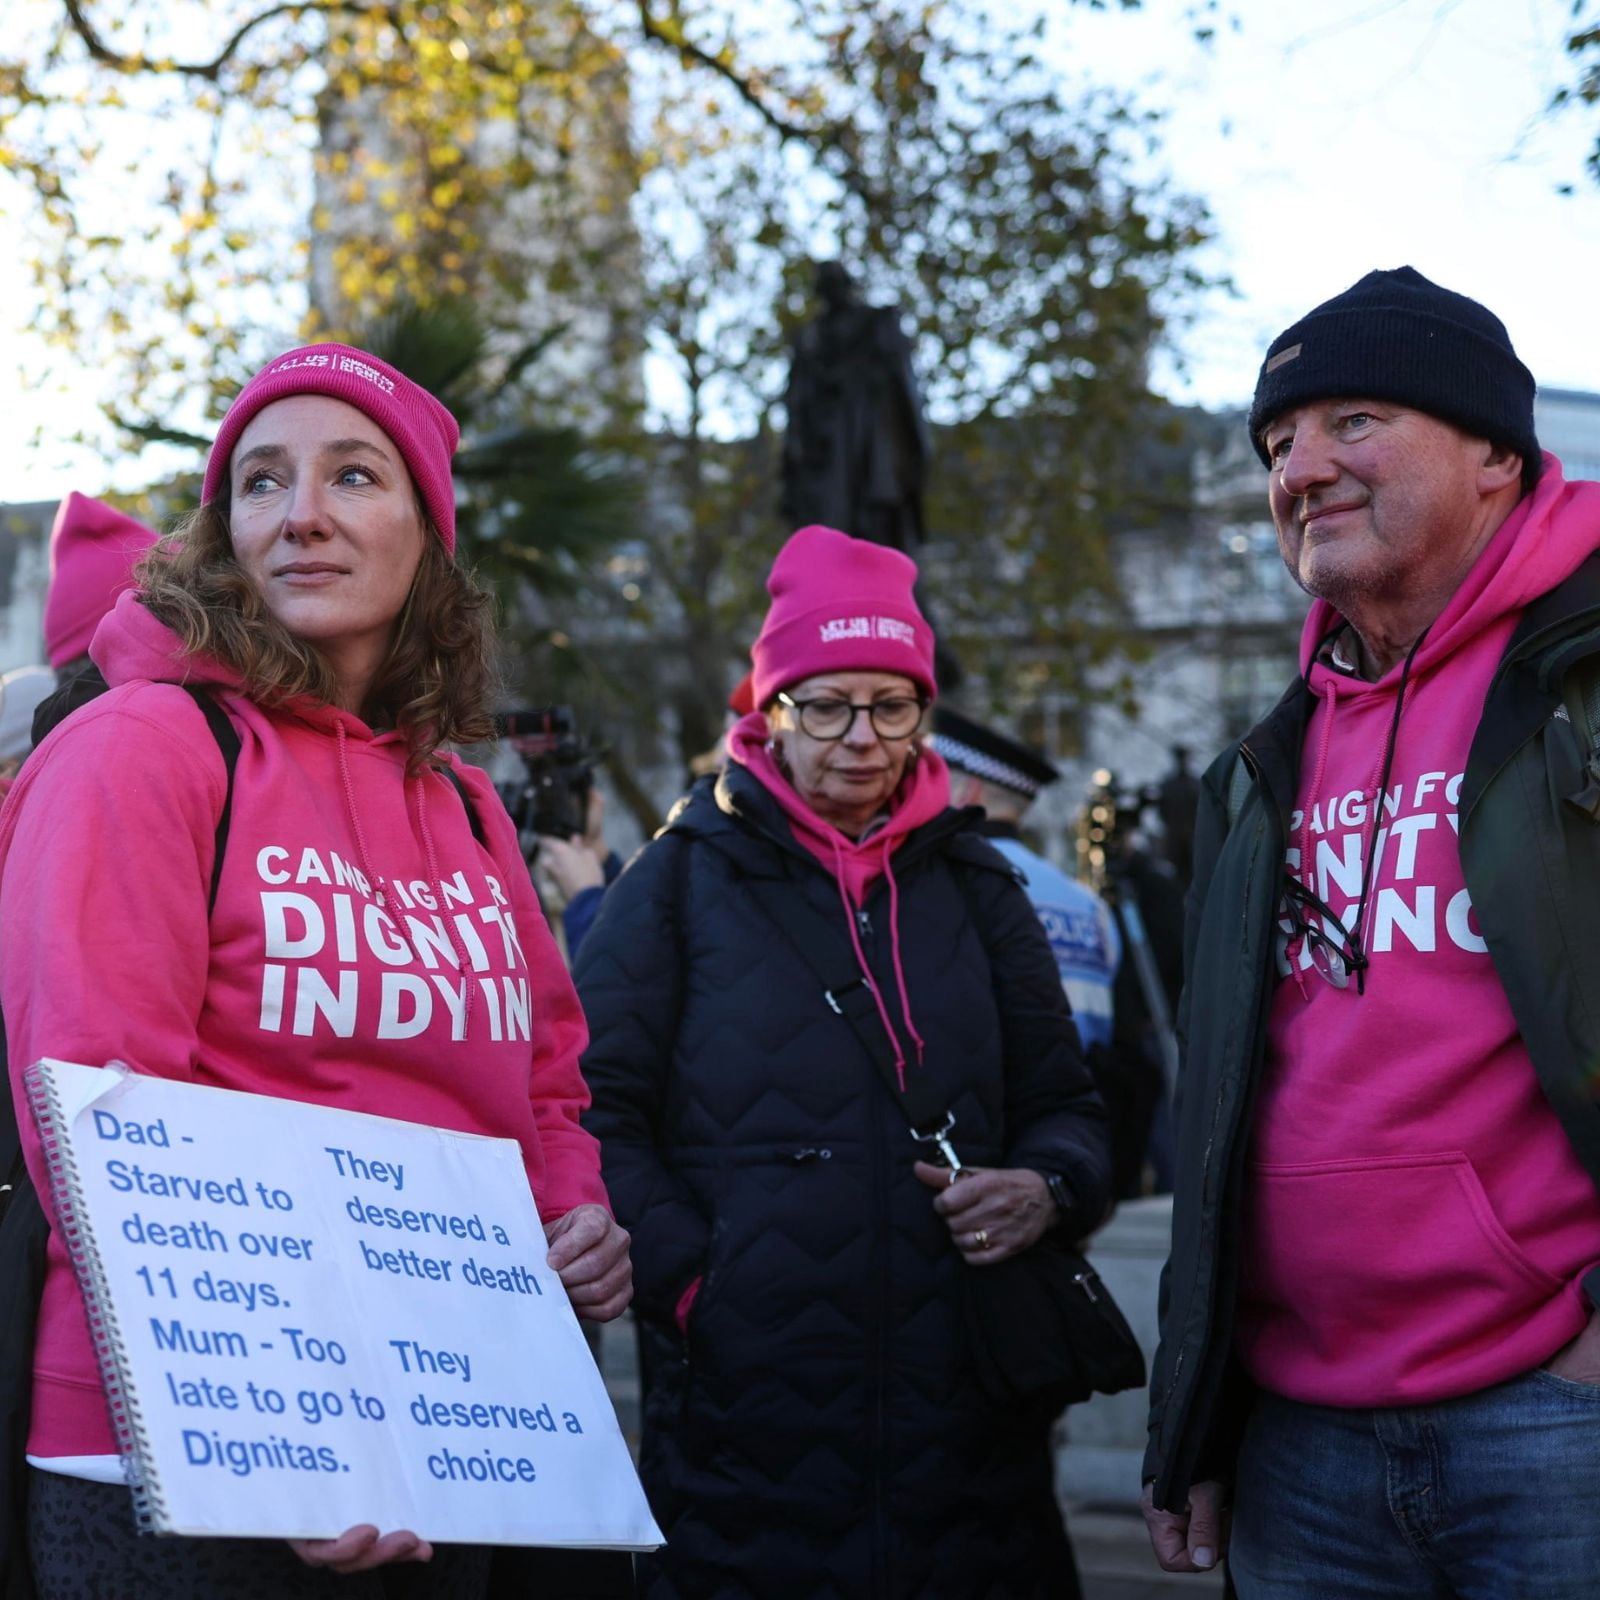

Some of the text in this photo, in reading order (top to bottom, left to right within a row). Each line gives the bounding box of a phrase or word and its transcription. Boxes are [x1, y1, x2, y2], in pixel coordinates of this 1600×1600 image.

[259, 963, 533, 1042] IN DYIN
[92, 1109, 171, 1148] Dad
[106, 1160, 293, 1212] Starved to
[324, 1147, 404, 1191] They
[122, 1213, 313, 1261] death over
[346, 1196, 511, 1246] deserved a
[136, 1265, 291, 1312] 11 days.
[359, 1240, 543, 1296] better death
[149, 1318, 249, 1358] Mum
[280, 1328, 347, 1365] Too
[389, 1340, 471, 1383] They
[166, 1372, 386, 1424] late to go to
[410, 1394, 584, 1434] deserved a
[182, 1430, 350, 1476] Dignitas.
[427, 1448, 537, 1483] choice
